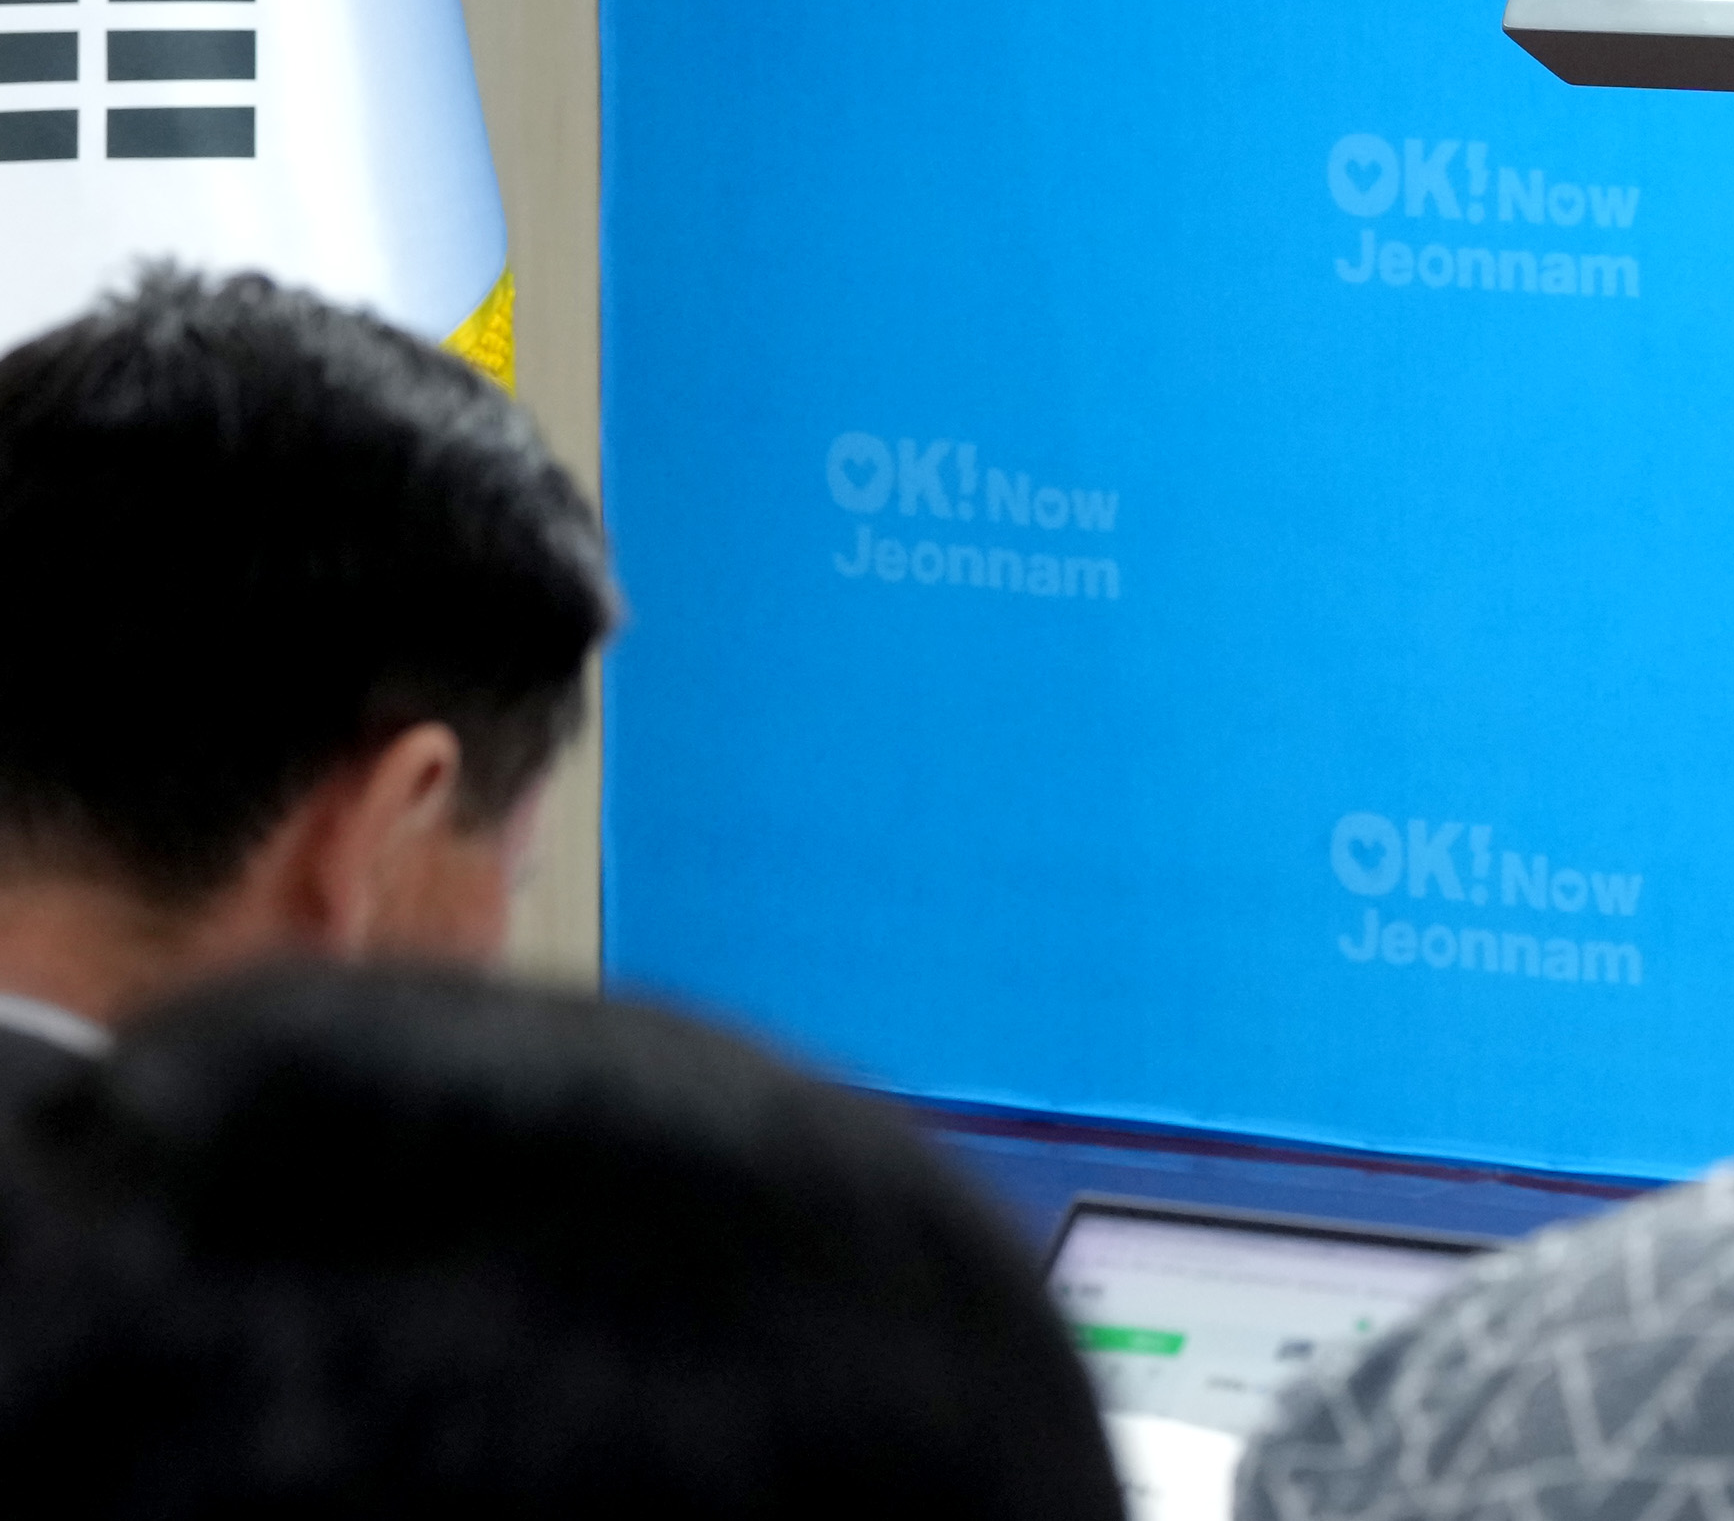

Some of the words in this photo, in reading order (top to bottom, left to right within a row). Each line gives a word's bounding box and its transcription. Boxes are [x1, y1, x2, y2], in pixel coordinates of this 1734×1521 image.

[1497, 167, 1641, 231] Now
[1334, 229, 1642, 300] Jeonnam
[985, 468, 1120, 533] Now
[833, 524, 1122, 603] Jeonnam
[1501, 853, 1644, 919] Now
[1338, 909, 1644, 988] Jeonnam
